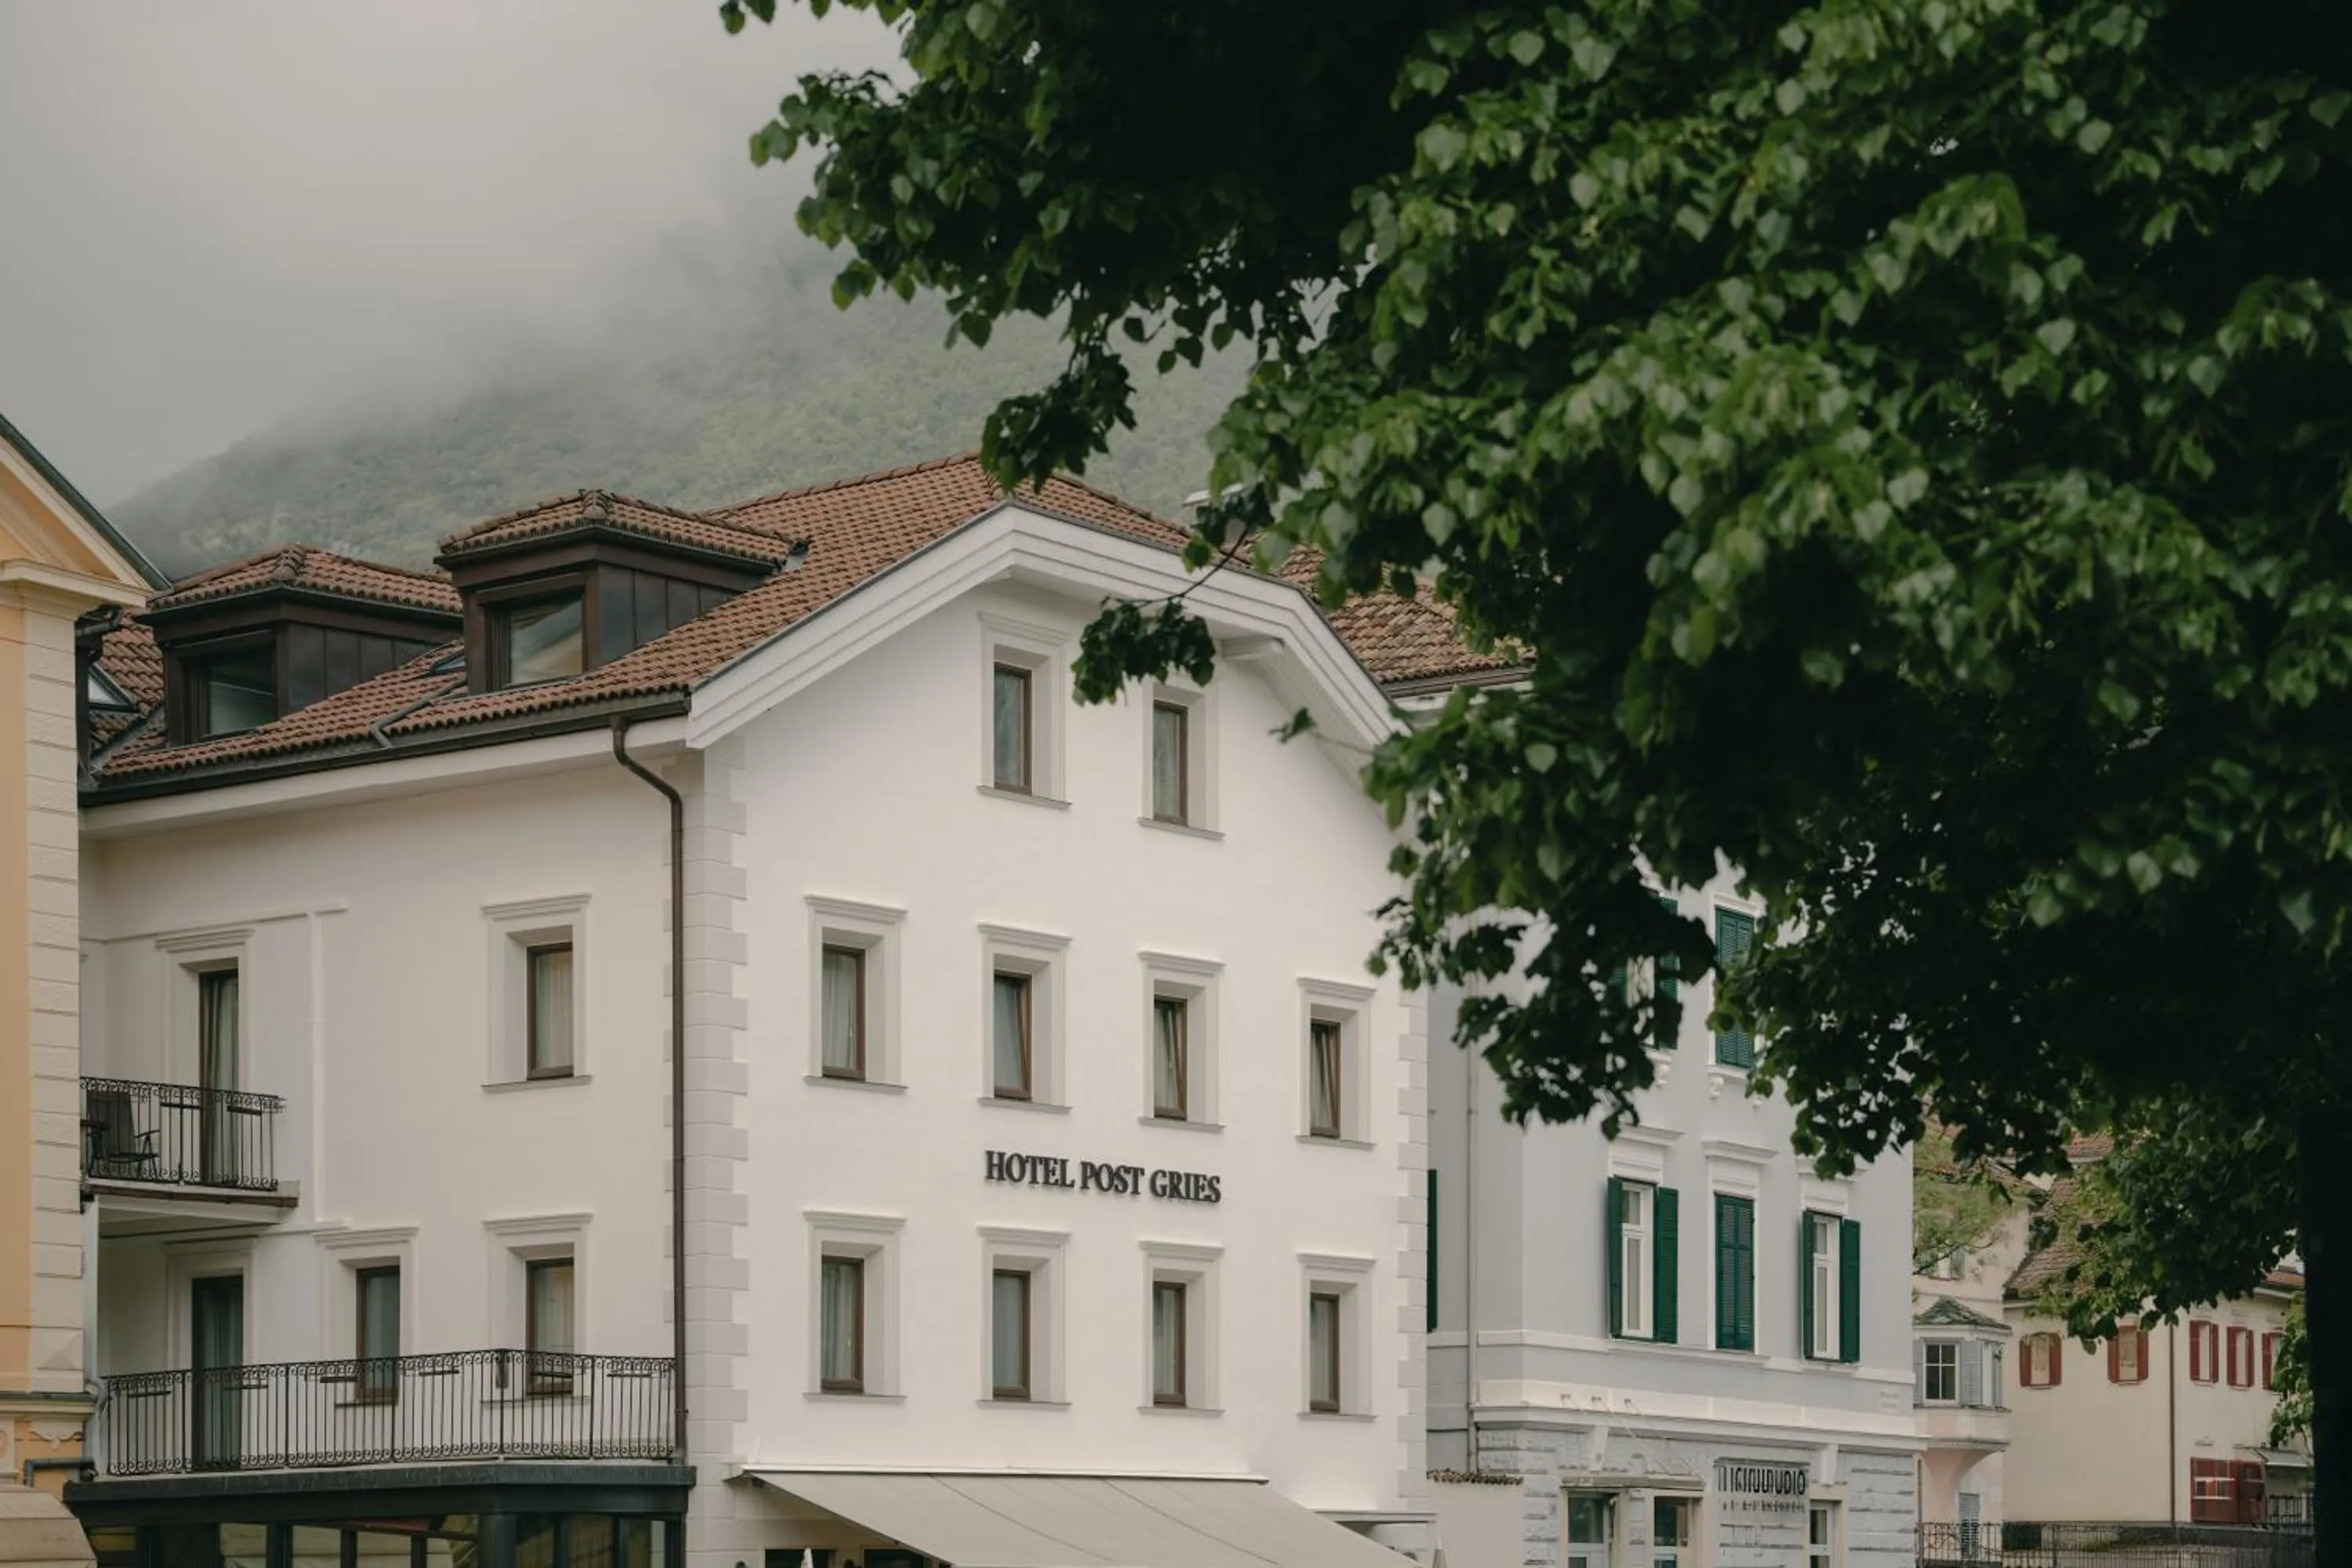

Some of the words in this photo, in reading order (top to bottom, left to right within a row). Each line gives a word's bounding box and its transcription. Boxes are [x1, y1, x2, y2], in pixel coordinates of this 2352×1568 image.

[985, 1150, 1075, 1189] HOTEL
[1080, 1161, 1145, 1196] POST
[1149, 1169, 1221, 1203] GRIES
